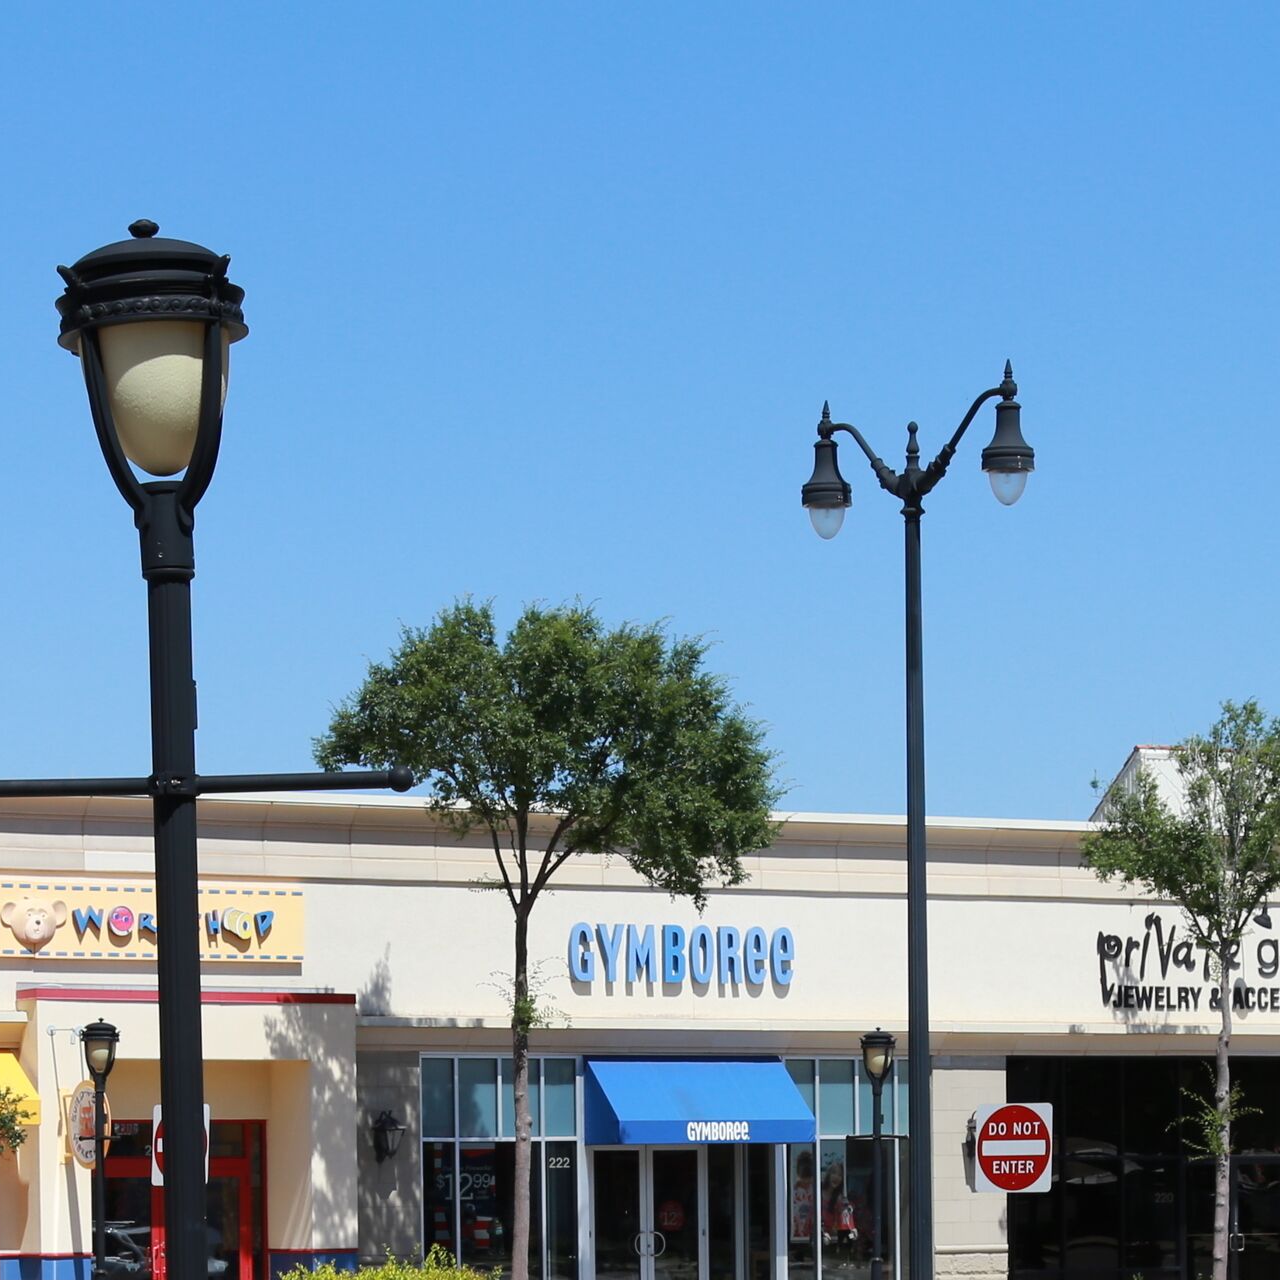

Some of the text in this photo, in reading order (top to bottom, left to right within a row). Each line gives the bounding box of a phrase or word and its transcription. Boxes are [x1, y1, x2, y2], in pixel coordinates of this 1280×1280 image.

[72, 905, 275, 942] WORHOP
[1113, 985, 1203, 1012] JEWELRY
[988, 1121, 1041, 1136] DO NOT
[548, 1157, 571, 1169] 222
[992, 1160, 1035, 1174] ENTER
